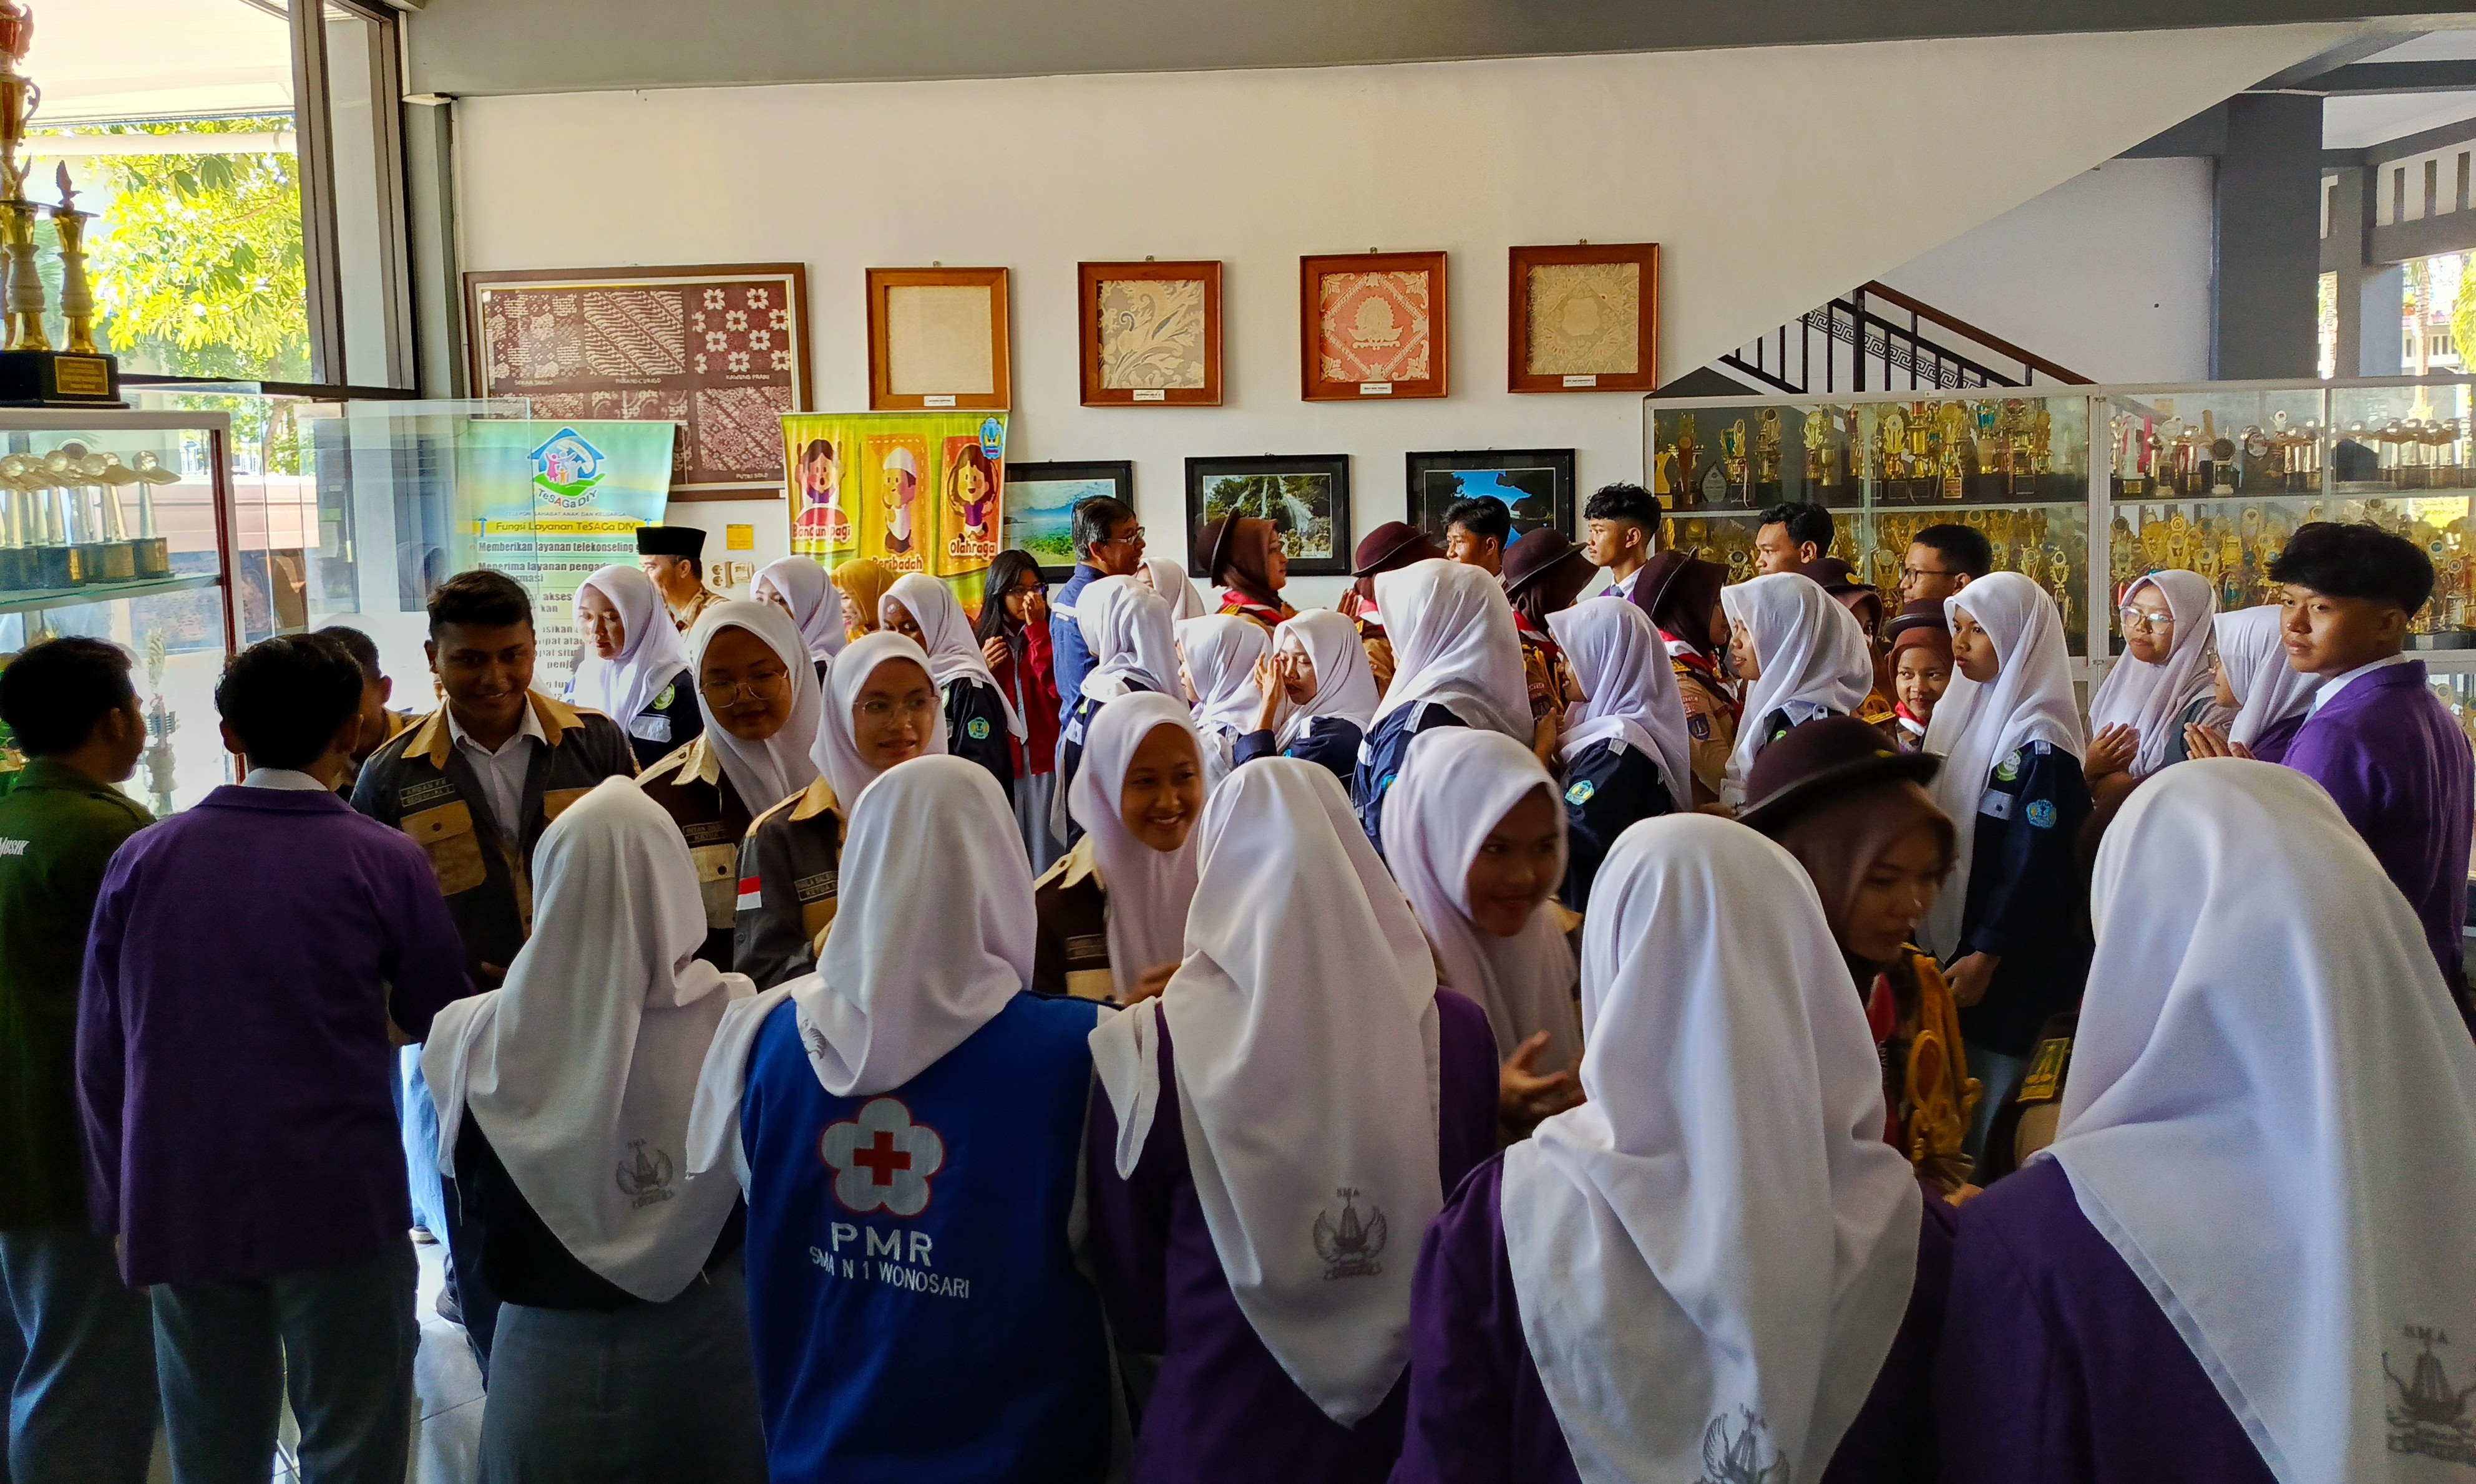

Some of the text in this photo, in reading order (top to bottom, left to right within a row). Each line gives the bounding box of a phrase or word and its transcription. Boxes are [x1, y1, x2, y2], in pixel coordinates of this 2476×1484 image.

[539, 488, 597, 508] TeSAGa DIY
[496, 522, 635, 531] Fungsi Layanan TeSAGa DIY
[792, 524, 851, 540] Bangun pagi
[479, 542, 532, 551] Memberikan
[573, 542, 633, 553] telekonseling
[950, 540, 995, 557] Olahraga
[479, 562, 525, 571] Menerima
[527, 562, 567, 571] layanan
[543, 593, 572, 601] akses
[831, 1221, 933, 1267] PMR
[810, 1246, 834, 1276] SMA
[842, 1259, 854, 1279] N
[879, 1261, 970, 1299] WONOSARI
